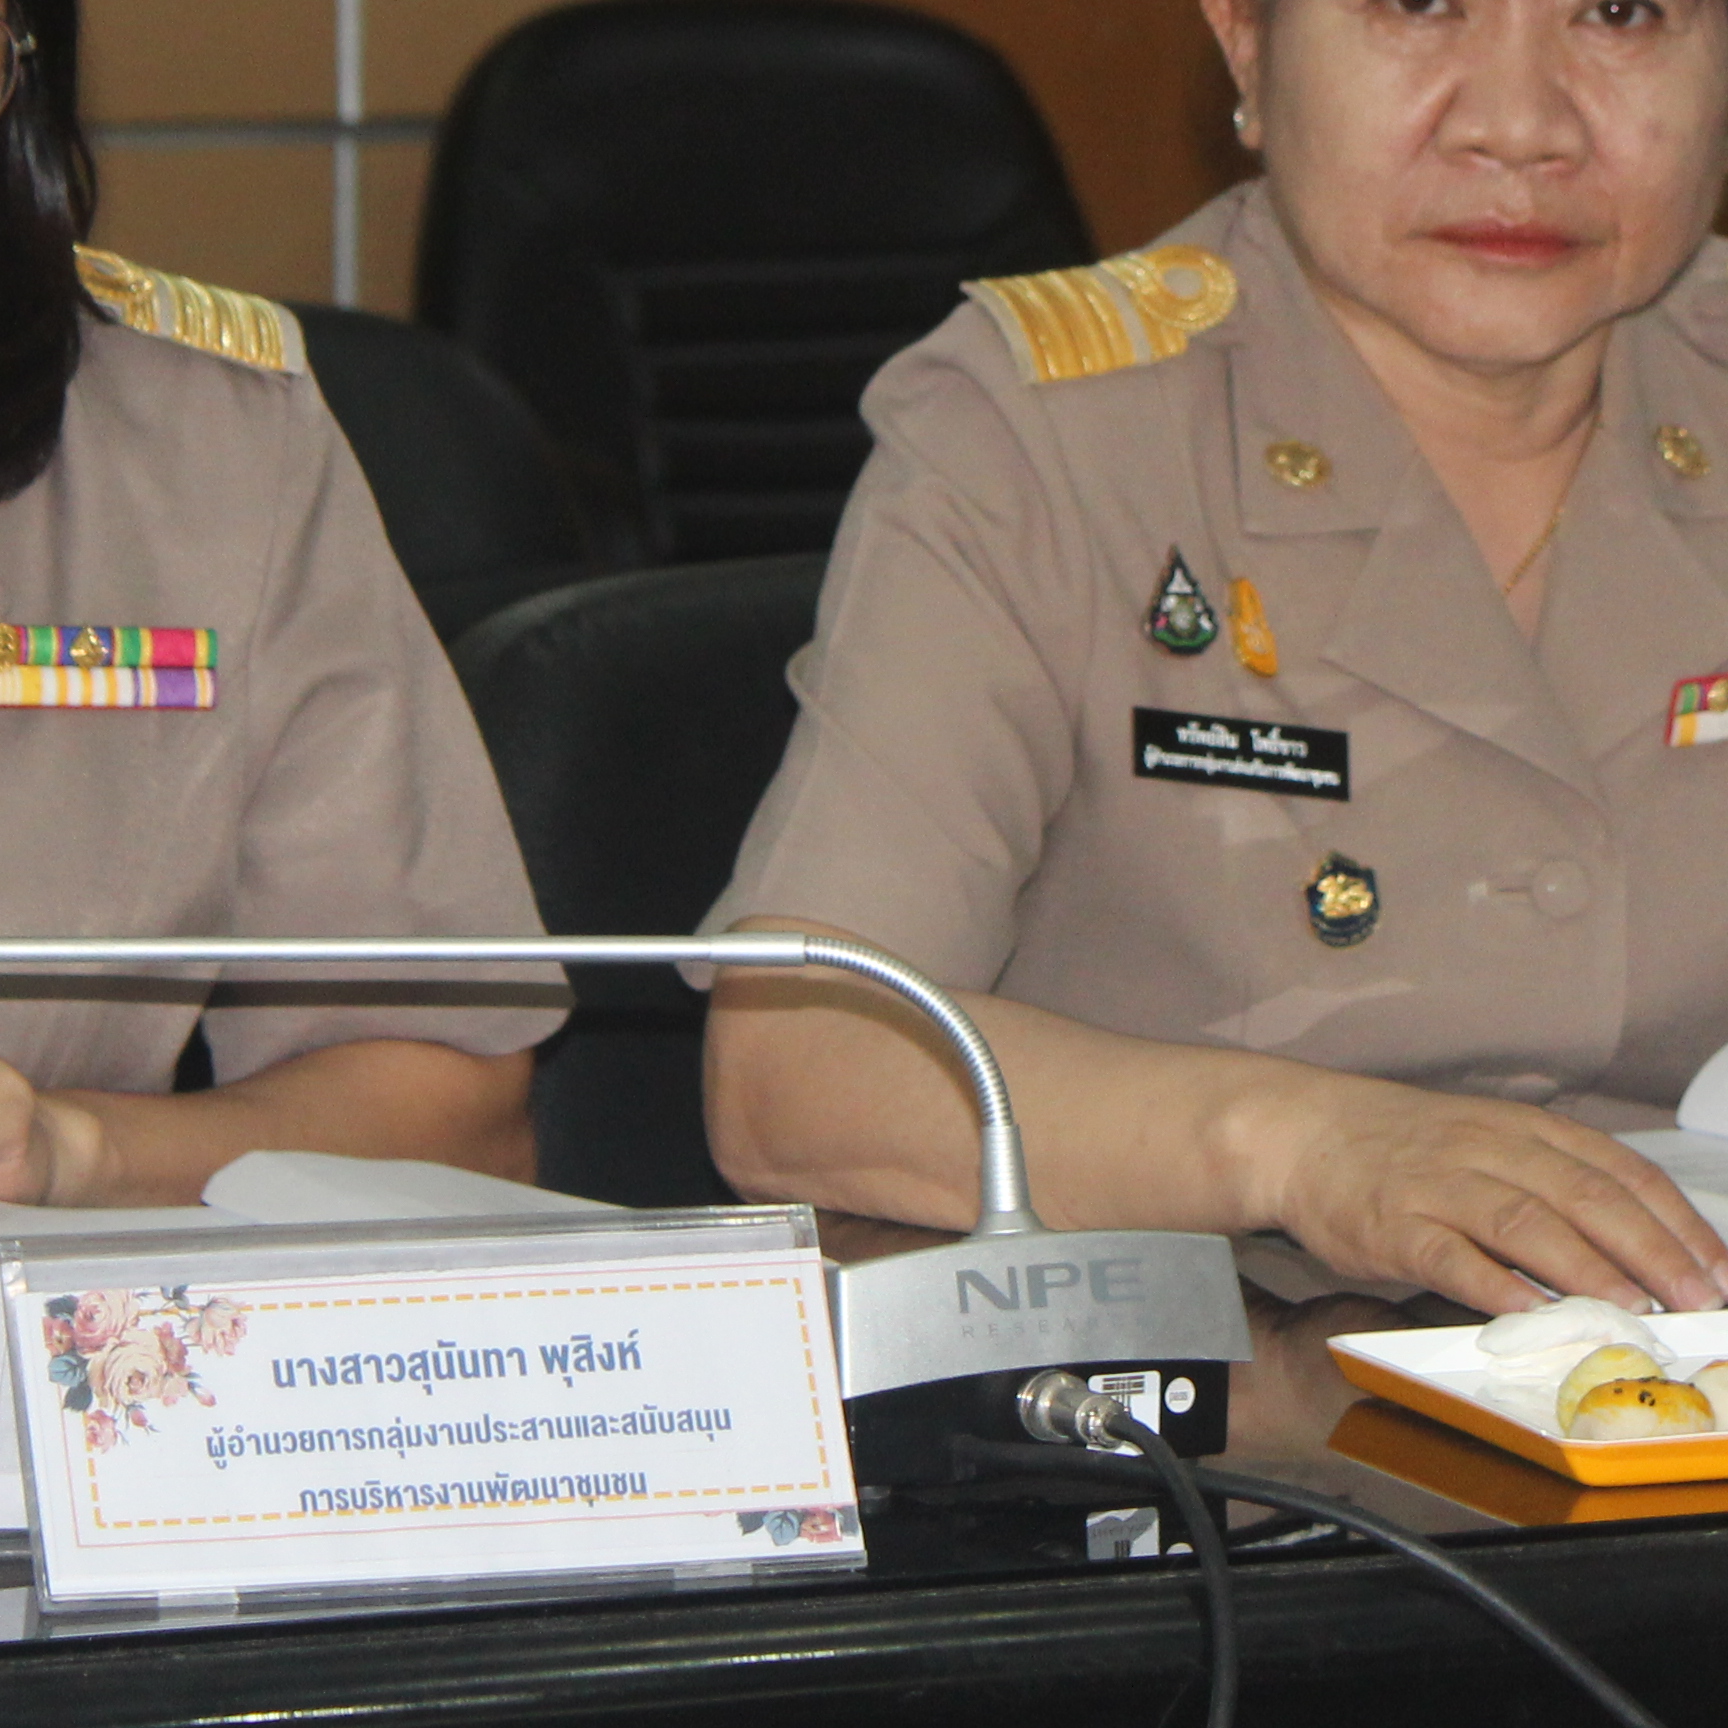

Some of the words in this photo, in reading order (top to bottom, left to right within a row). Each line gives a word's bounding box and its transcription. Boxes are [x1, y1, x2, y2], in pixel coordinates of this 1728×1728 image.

[955, 1257, 1146, 1314] NPE
[272, 1338, 527, 1395] นางสาวสุนันทา
[539, 1328, 642, 1388] พุสิงห์
[205, 1403, 732, 1470] ผู้อำนวยการกลุ่มงานประสานและสนับสนุน
[298, 1468, 648, 1514] การบริหารงานพัฒนาชุมชน
